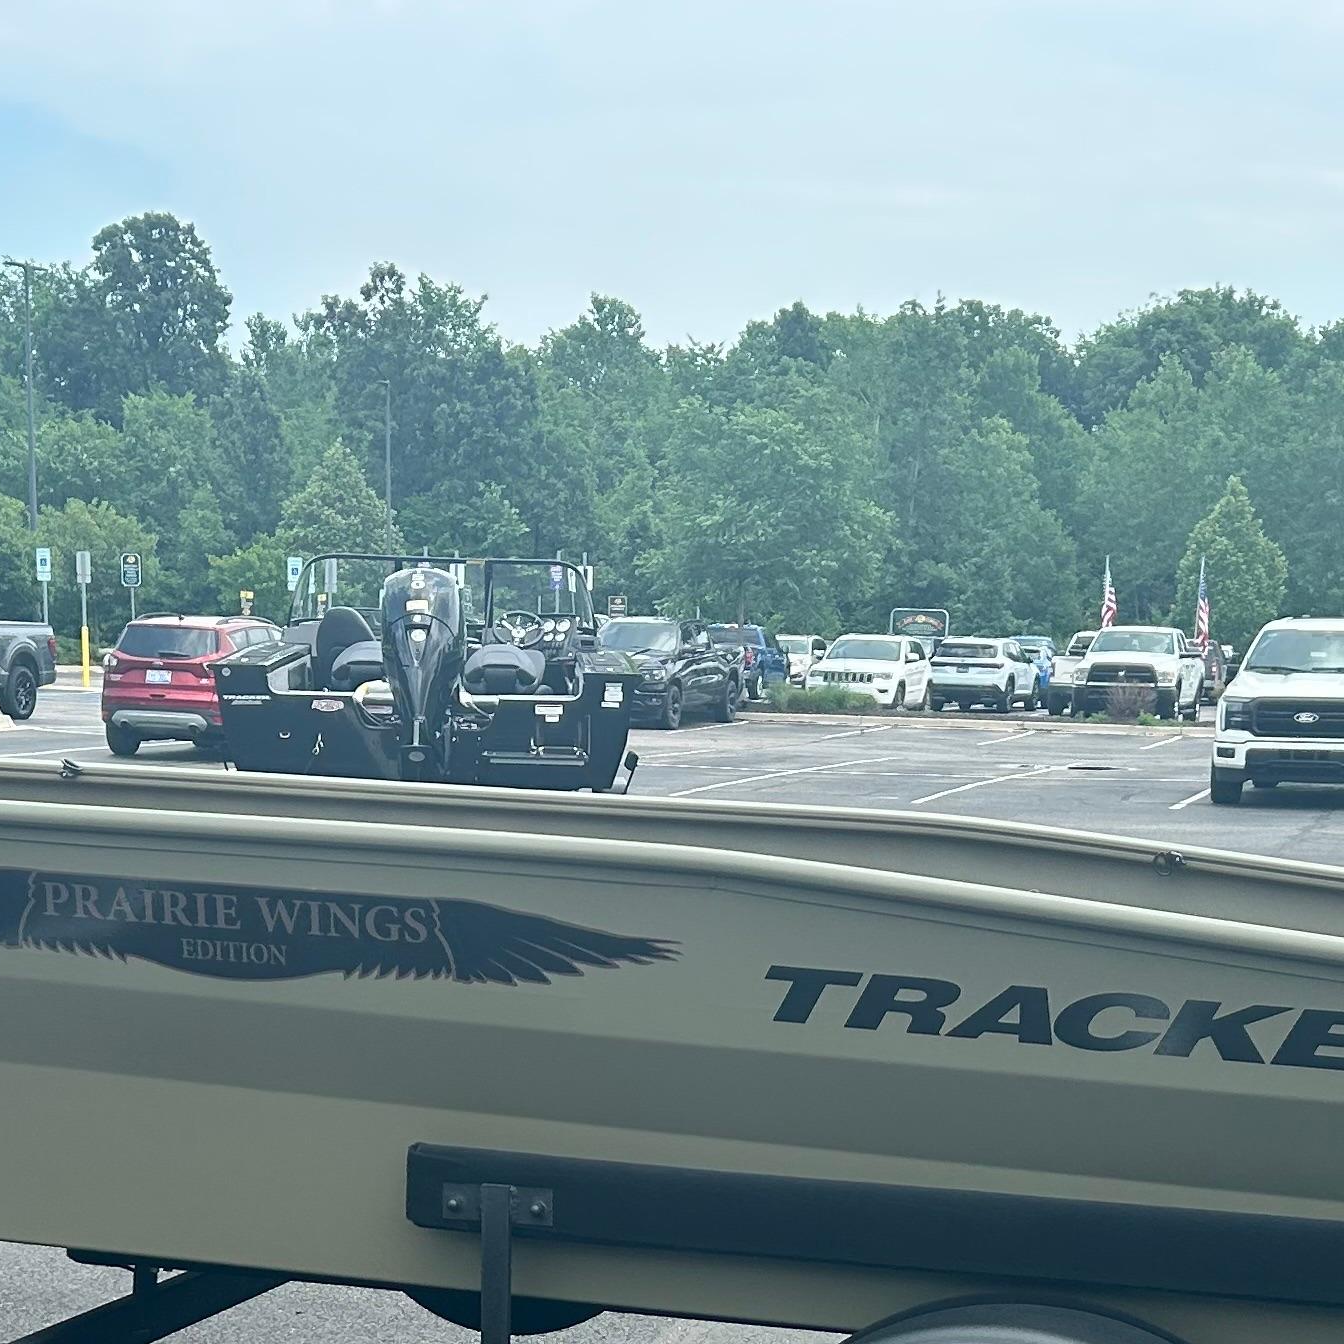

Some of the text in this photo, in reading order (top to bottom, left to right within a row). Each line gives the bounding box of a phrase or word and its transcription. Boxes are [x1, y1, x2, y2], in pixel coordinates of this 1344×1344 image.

[42, 882, 428, 944] PRAIRIE WINGS
[180, 938, 286, 966] EDITION
